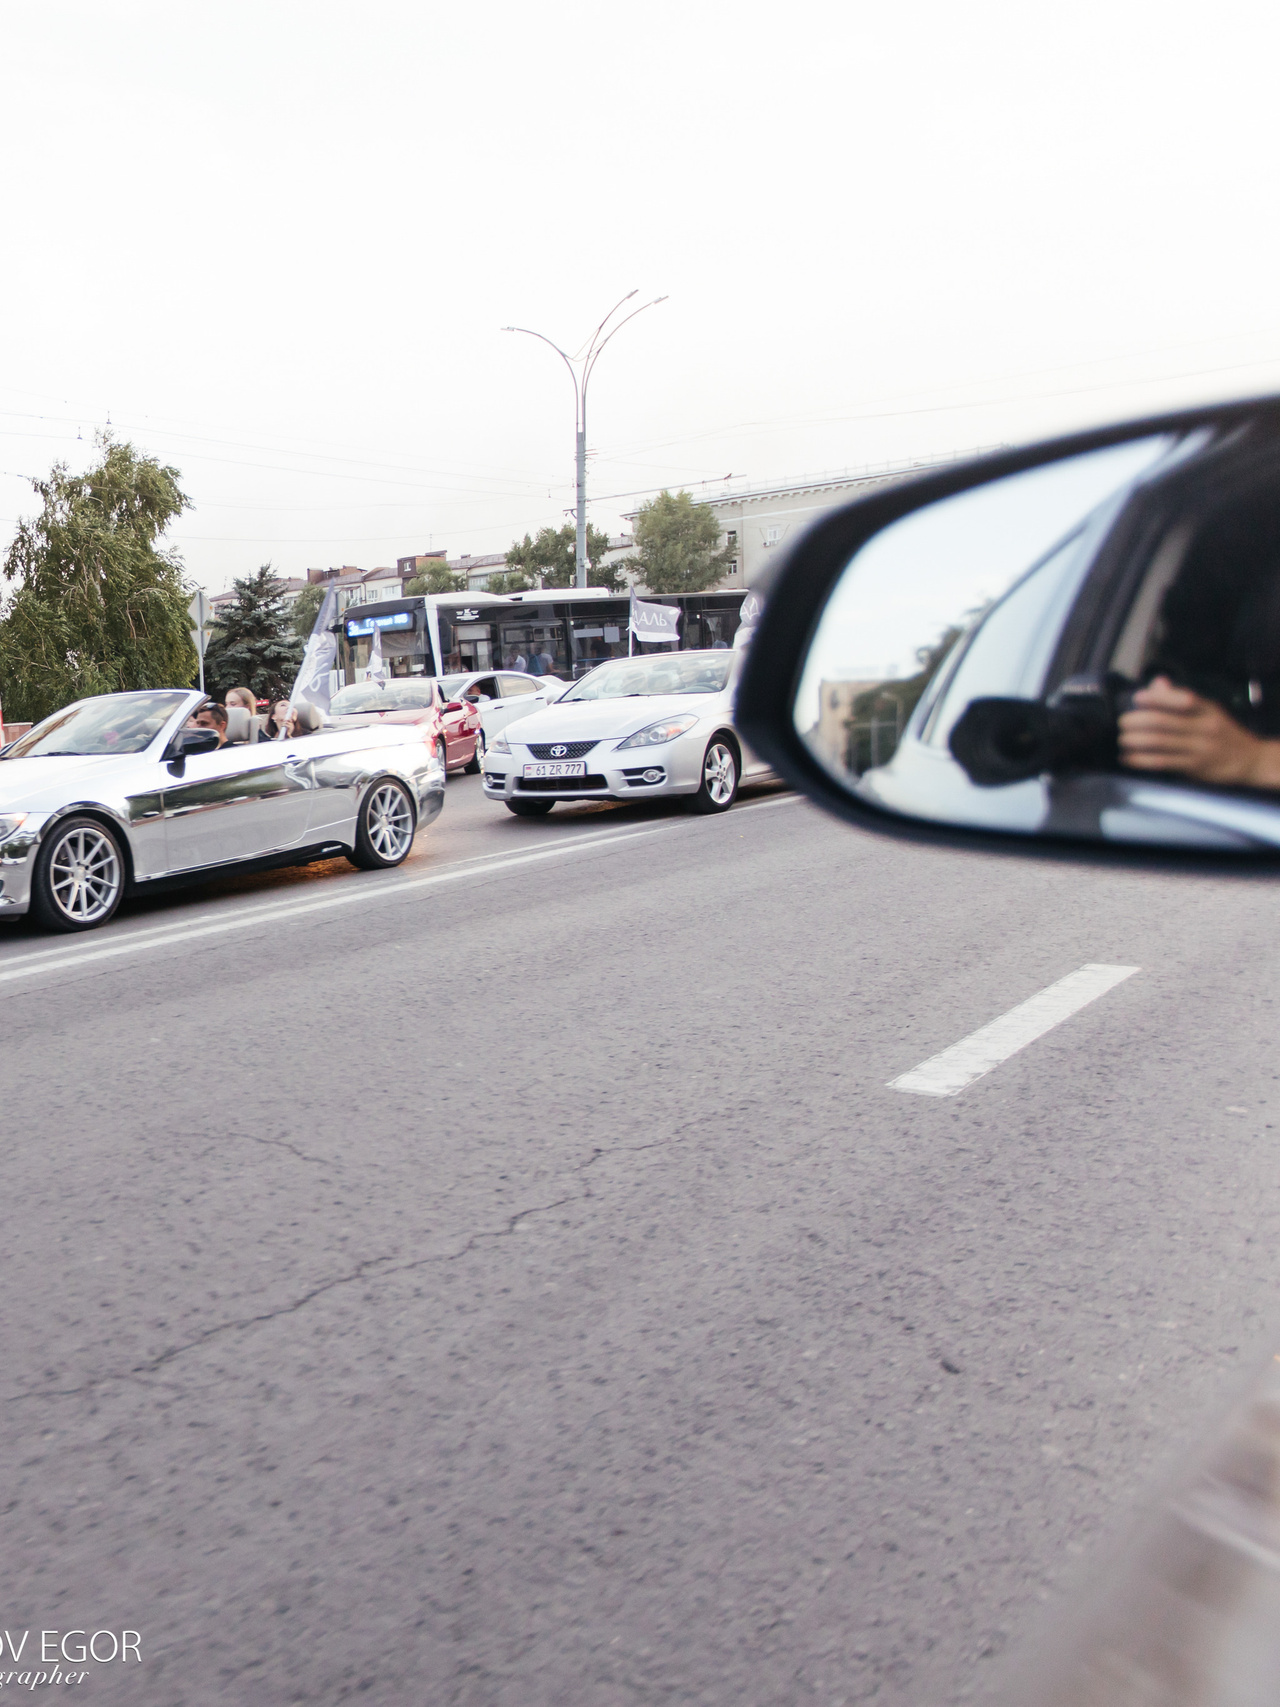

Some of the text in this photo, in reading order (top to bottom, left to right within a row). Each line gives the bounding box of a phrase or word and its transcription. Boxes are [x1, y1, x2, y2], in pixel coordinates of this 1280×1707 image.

[536, 763, 582, 776] 61 ZR 777
